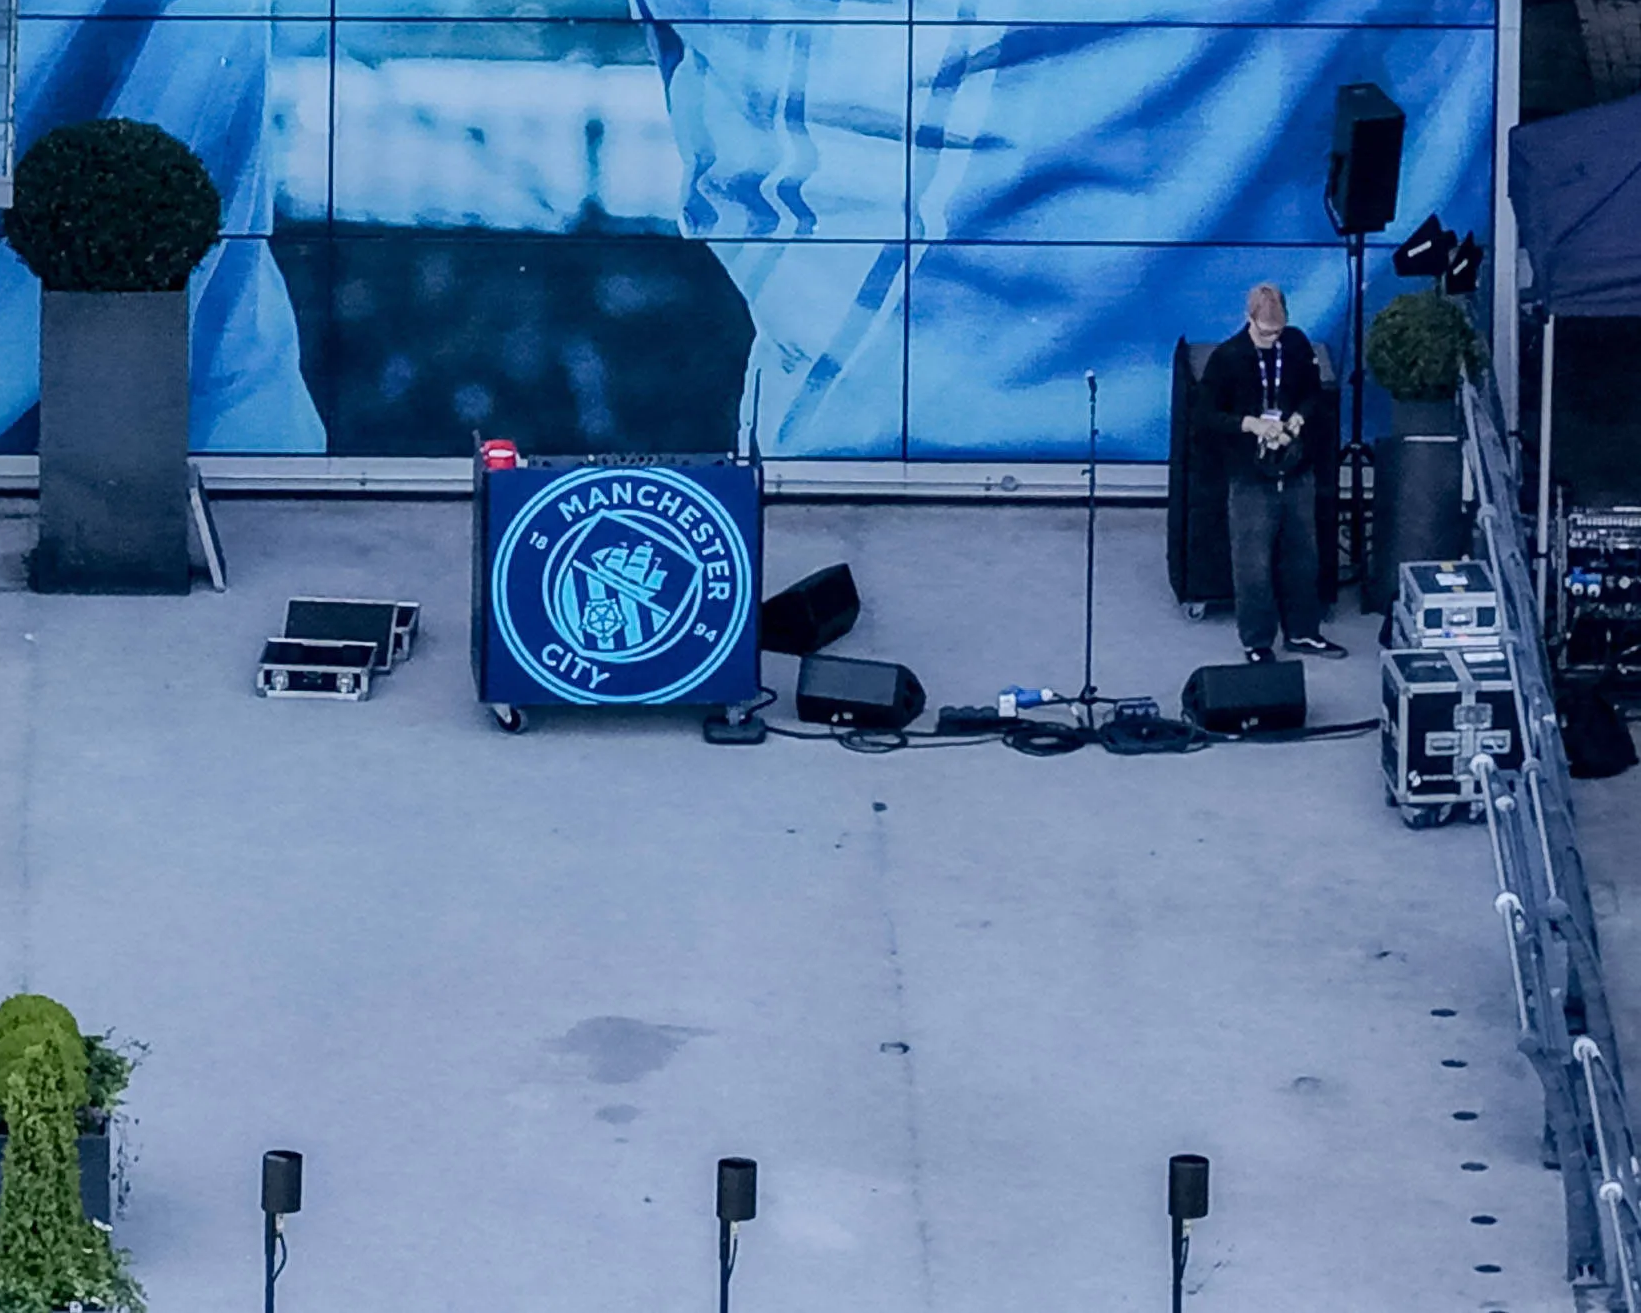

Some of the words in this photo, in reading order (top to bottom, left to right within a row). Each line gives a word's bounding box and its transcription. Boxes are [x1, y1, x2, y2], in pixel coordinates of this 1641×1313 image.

[528, 531, 549, 550] 18
[693, 623, 718, 643] 94
[557, 481, 730, 602] MANCHESTER
[541, 643, 611, 690] CITY
